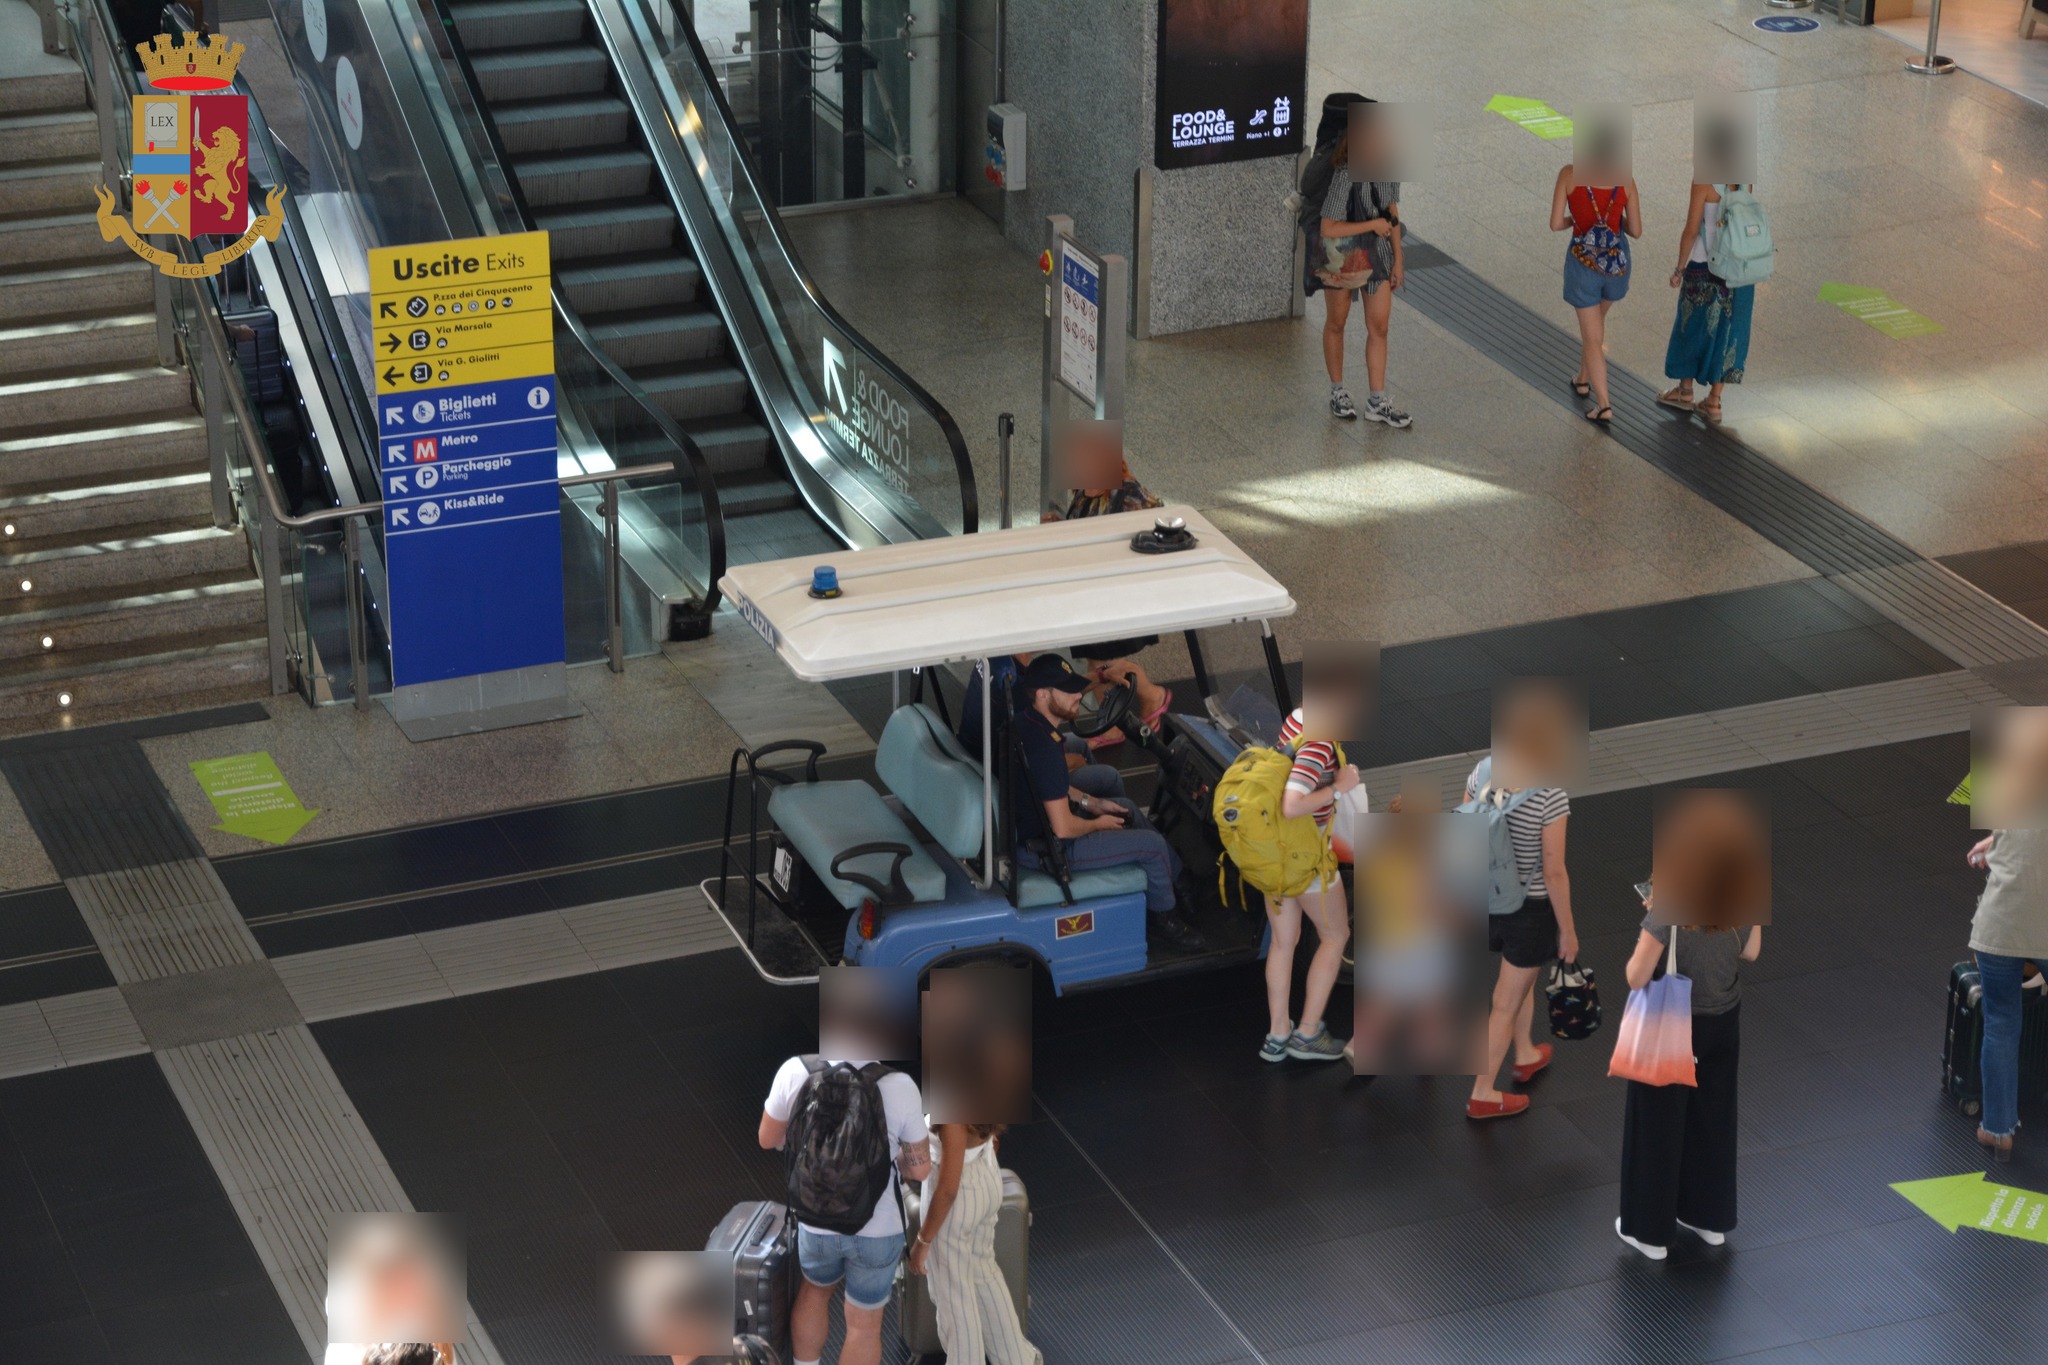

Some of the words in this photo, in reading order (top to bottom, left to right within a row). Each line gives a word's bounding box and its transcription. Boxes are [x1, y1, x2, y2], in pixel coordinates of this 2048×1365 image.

[1172, 108, 1226, 127] FOOD&
[1172, 121, 1234, 140] LOUNGE
[1173, 139, 1206, 148] TERRAZZA
[1208, 134, 1234, 144] TERMINI
[394, 253, 479, 280] Uscite
[486, 252, 525, 271] Exits
[434, 292, 456, 302] P.zza
[459, 290, 474, 299] dei
[476, 284, 533, 297] Cinquecento
[436, 326, 452, 334] Via
[454, 321, 492, 332] Marsala
[438, 358, 453, 367] Via
[456, 356, 466, 365] G.
[469, 352, 500, 363] Giolitti
[439, 392, 497, 412] Biglietti
[440, 410, 471, 422] Tickets
[442, 435, 478, 447] Metro
[442, 457, 512, 474] Parcheggio
[443, 471, 468, 481] Parking
[444, 493, 504, 510] Kiss&Ride
[738, 594, 775, 650] POLIZIA
